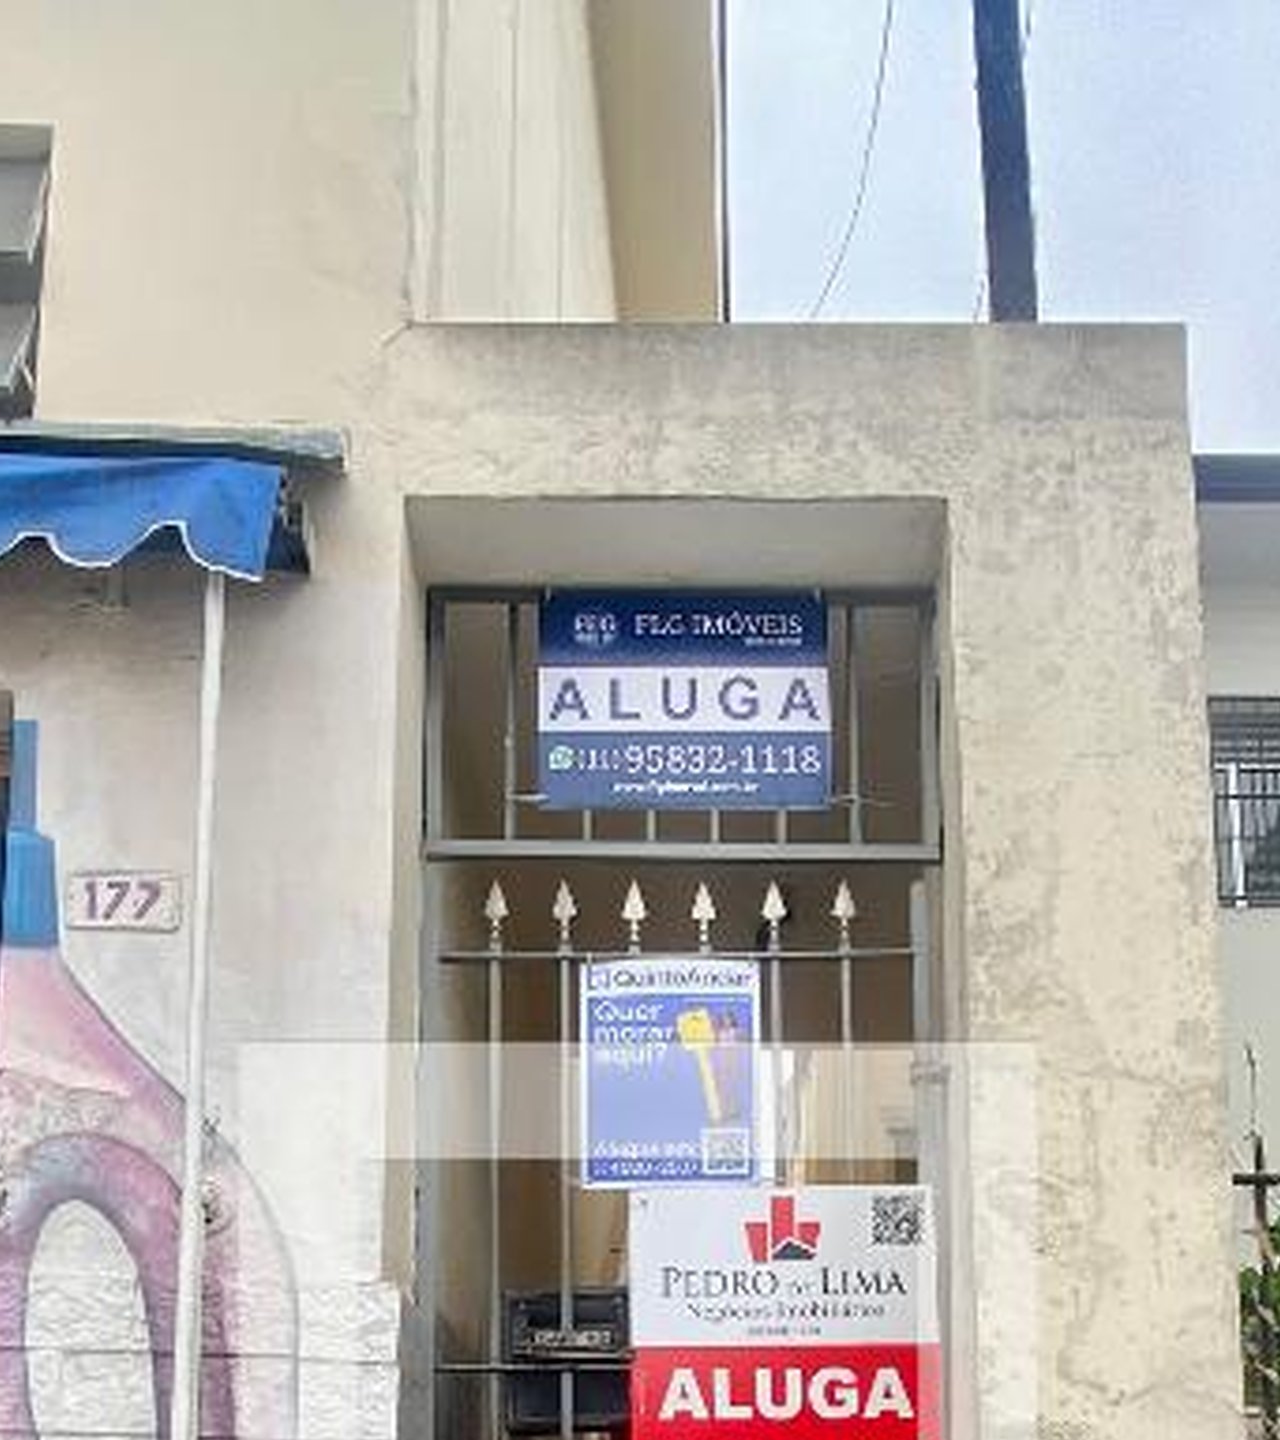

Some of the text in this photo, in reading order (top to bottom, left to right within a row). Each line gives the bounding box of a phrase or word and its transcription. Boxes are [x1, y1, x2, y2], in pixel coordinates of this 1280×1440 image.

[693, 610, 804, 635] IMÓVEIS
[548, 675, 821, 721] ALUGA
[84, 880, 162, 921] 177
[593, 1000, 665, 1022] Quer
[593, 1025, 674, 1043] morar
[662, 1266, 779, 1298] PEDRO
[822, 1266, 907, 1296] LIMA
[658, 1366, 915, 1420] ALUGA
